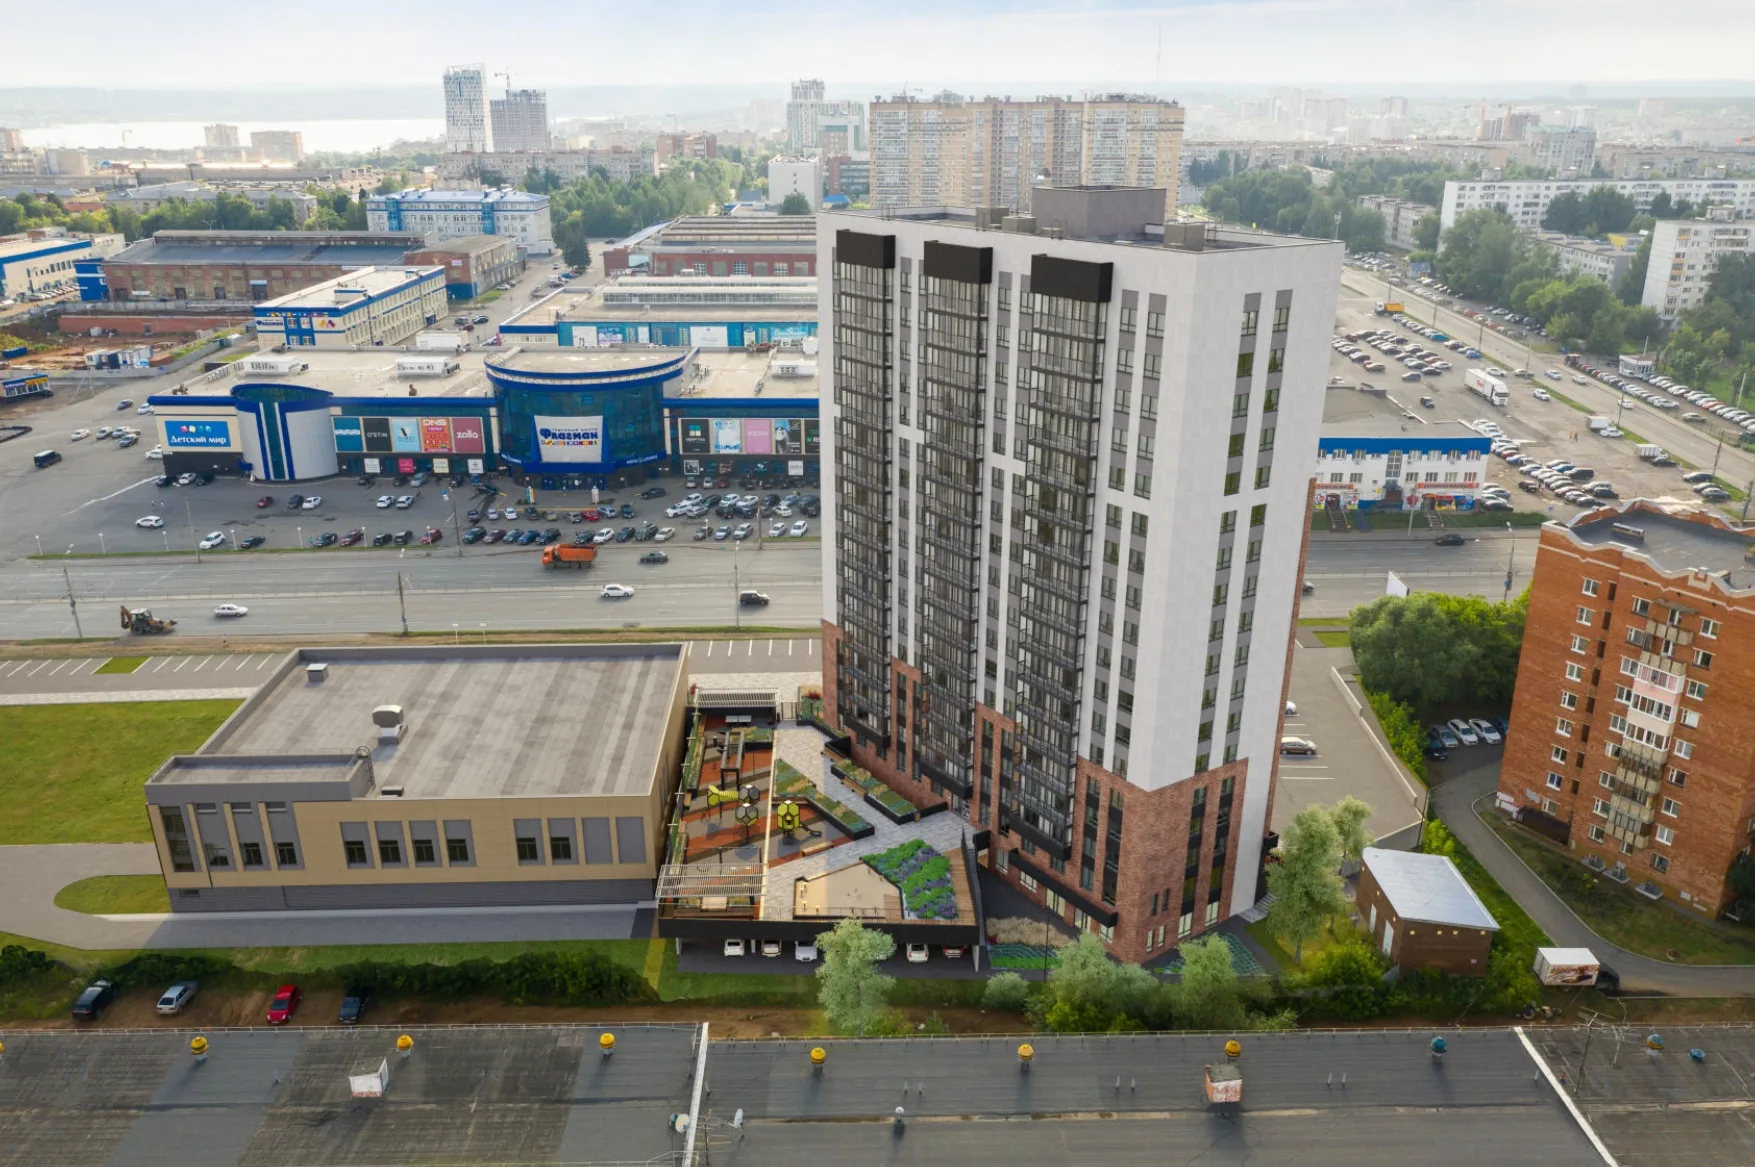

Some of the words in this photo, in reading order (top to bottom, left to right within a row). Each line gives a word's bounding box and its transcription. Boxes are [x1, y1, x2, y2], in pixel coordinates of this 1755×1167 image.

[456, 429, 479, 439] zolla
[540, 428, 598, 440] Флагман
[171, 435, 206, 444] Детский
[208, 437, 227, 445] мир
